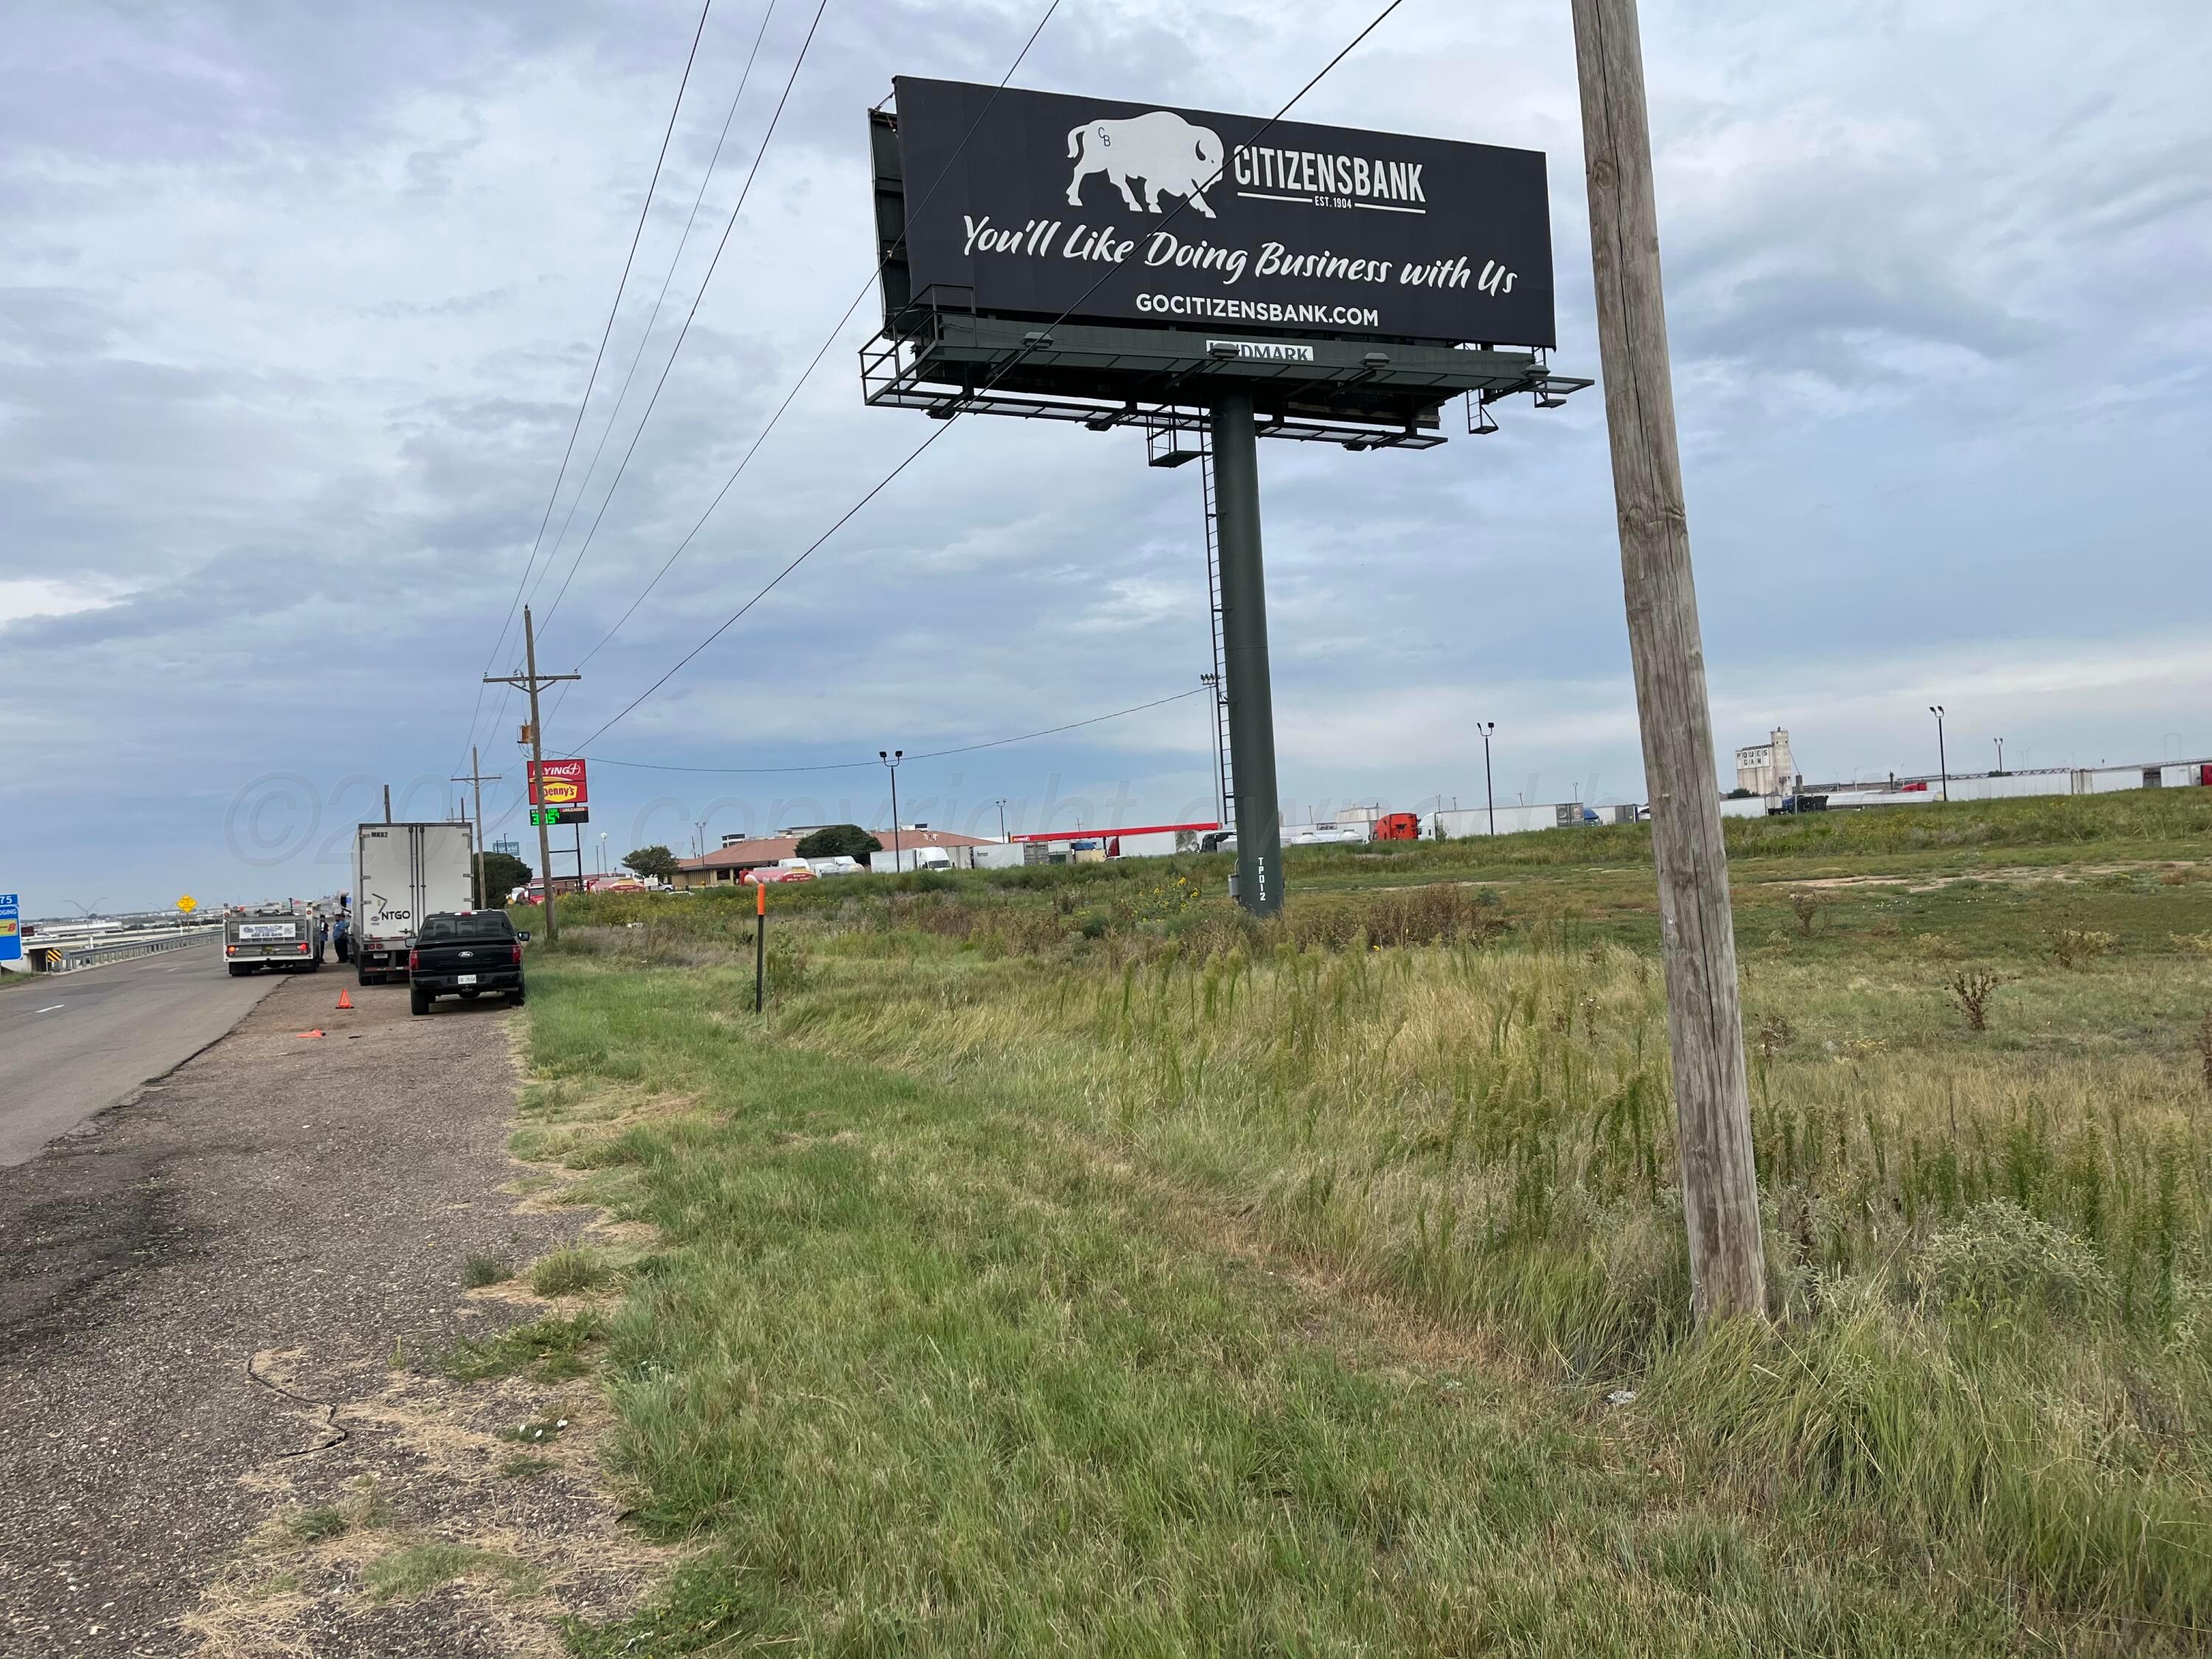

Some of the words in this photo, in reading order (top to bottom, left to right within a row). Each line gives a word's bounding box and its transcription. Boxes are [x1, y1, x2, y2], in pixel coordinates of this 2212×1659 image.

[1234, 145, 1427, 204] CITIZENSBANK
[963, 215, 1062, 257] You'll
[1062, 224, 1135, 263] Like
[1144, 232, 1248, 285] Doing
[1255, 241, 1393, 283] Business
[1400, 256, 1471, 289] with
[1478, 260, 1518, 296] Us
[1135, 293, 1379, 327] GOCITIZENSBANK.COM
[1209, 341, 1309, 361] DMARK
[381, 911, 411, 921] NTGO
